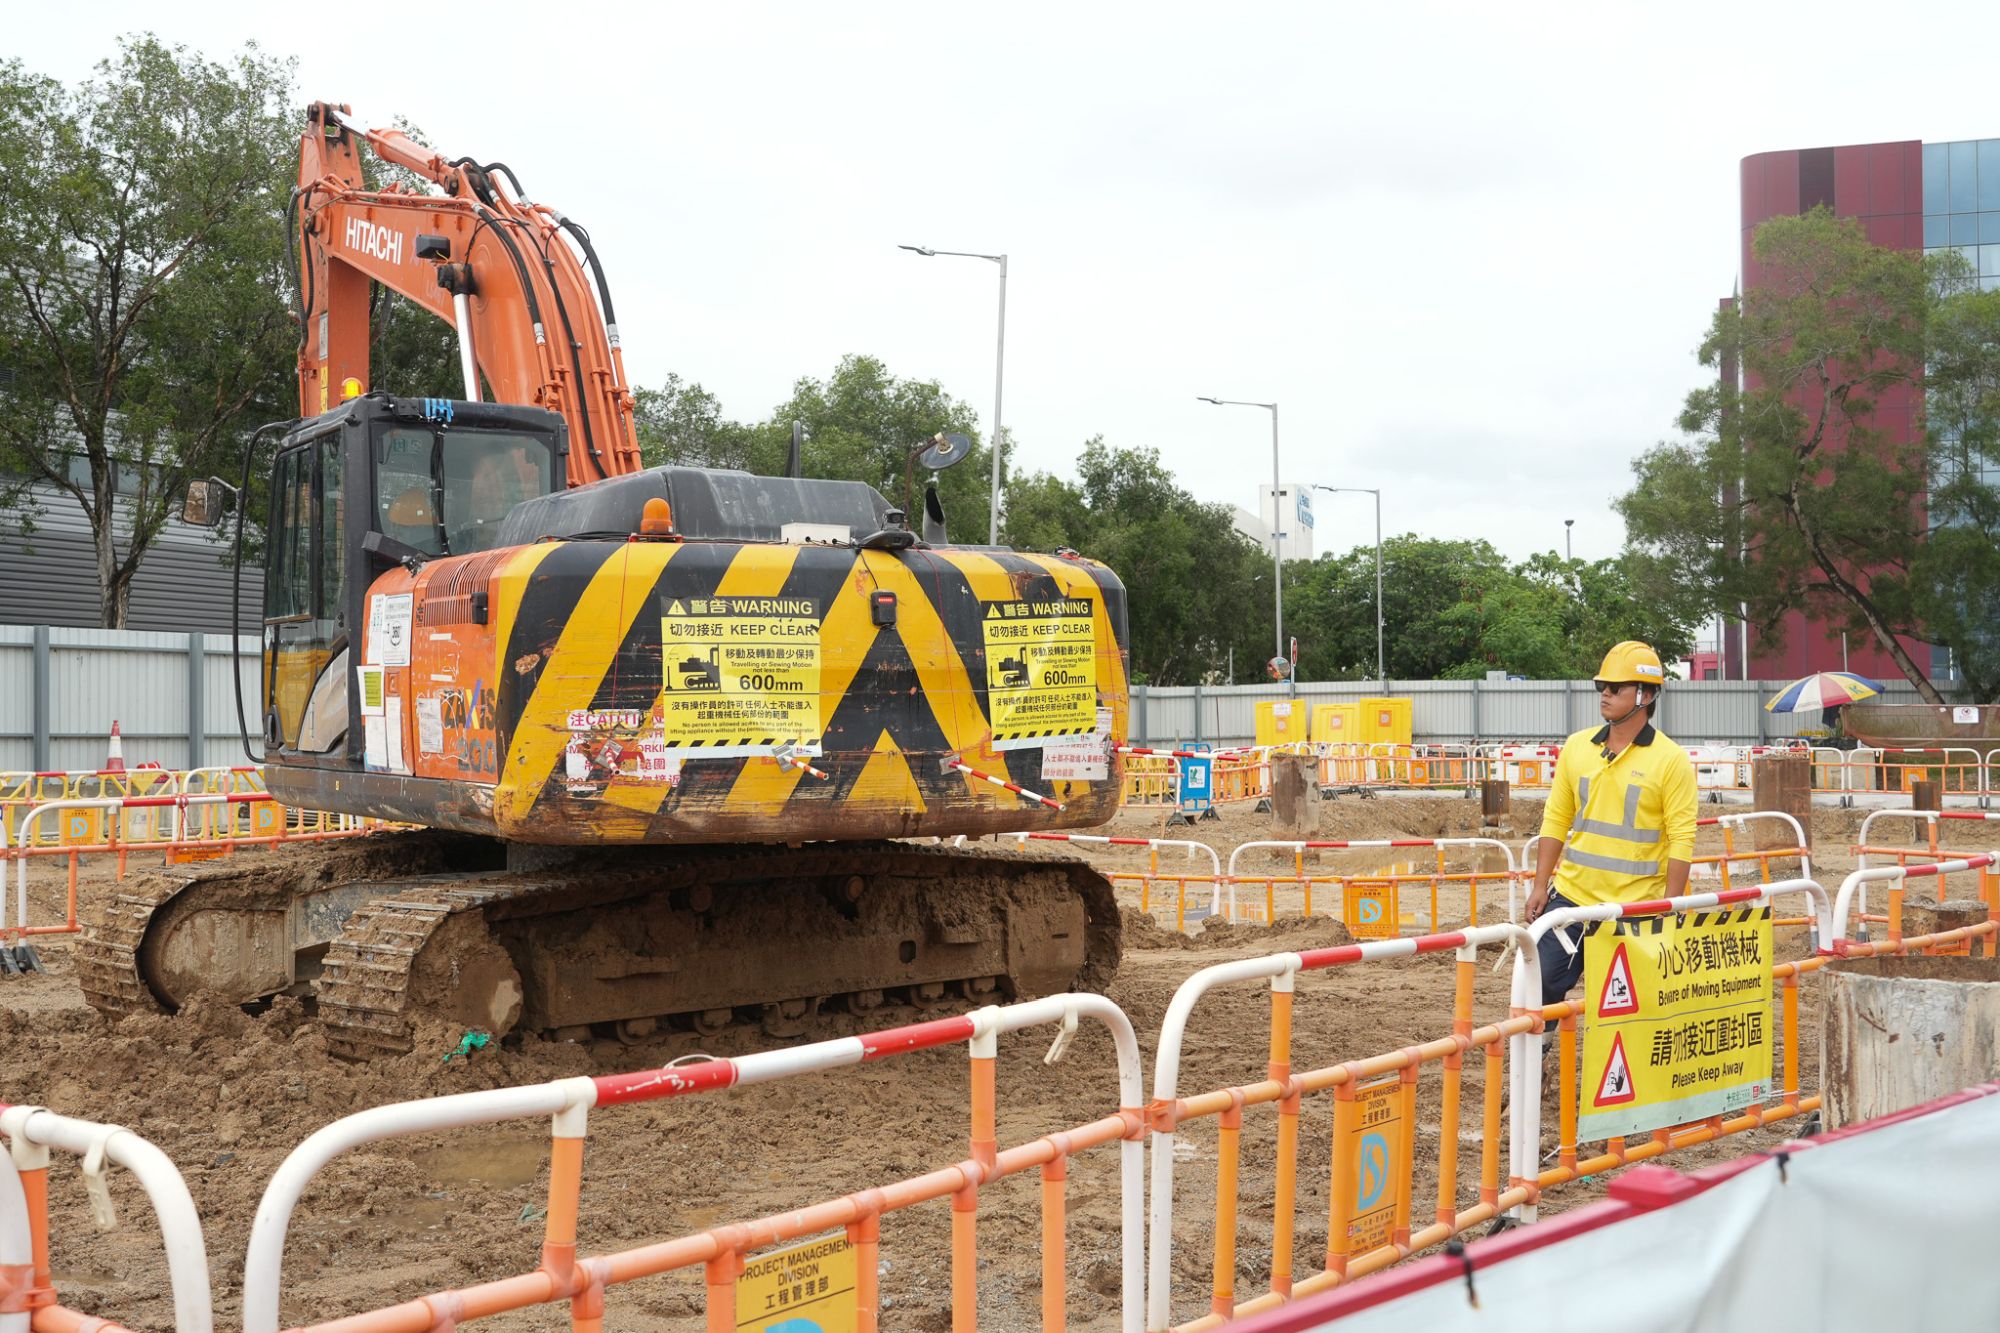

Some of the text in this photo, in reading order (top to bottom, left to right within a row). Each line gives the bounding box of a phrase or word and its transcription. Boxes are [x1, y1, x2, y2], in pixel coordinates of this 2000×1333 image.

[346, 216, 403, 265] HITACHI
[691, 599, 813, 615] 警告 WARNING
[1003, 601, 1088, 616] 警告 WARNING
[670, 623, 814, 636] 切勿接近 KEEP CLEAR
[989, 623, 1091, 638] 切勿接近 KEEP CLEAR
[739, 674, 803, 691] 600mm
[1044, 670, 1086, 686] 600mm
[456, 736, 497, 773] 200
[1658, 929, 1761, 979] 小心移動機械
[1681, 984, 1690, 999] of
[1692, 980, 1720, 998] Moving
[1722, 974, 1762, 997] Equipment
[1650, 1011, 1763, 1066] 請勿接近圍封區
[1672, 1061, 1744, 1089] Please Keep Away
[788, 1238, 852, 1267] MANAGEMEN
[778, 1262, 819, 1286] DIVISION
[765, 1275, 829, 1310] 工程管理部
